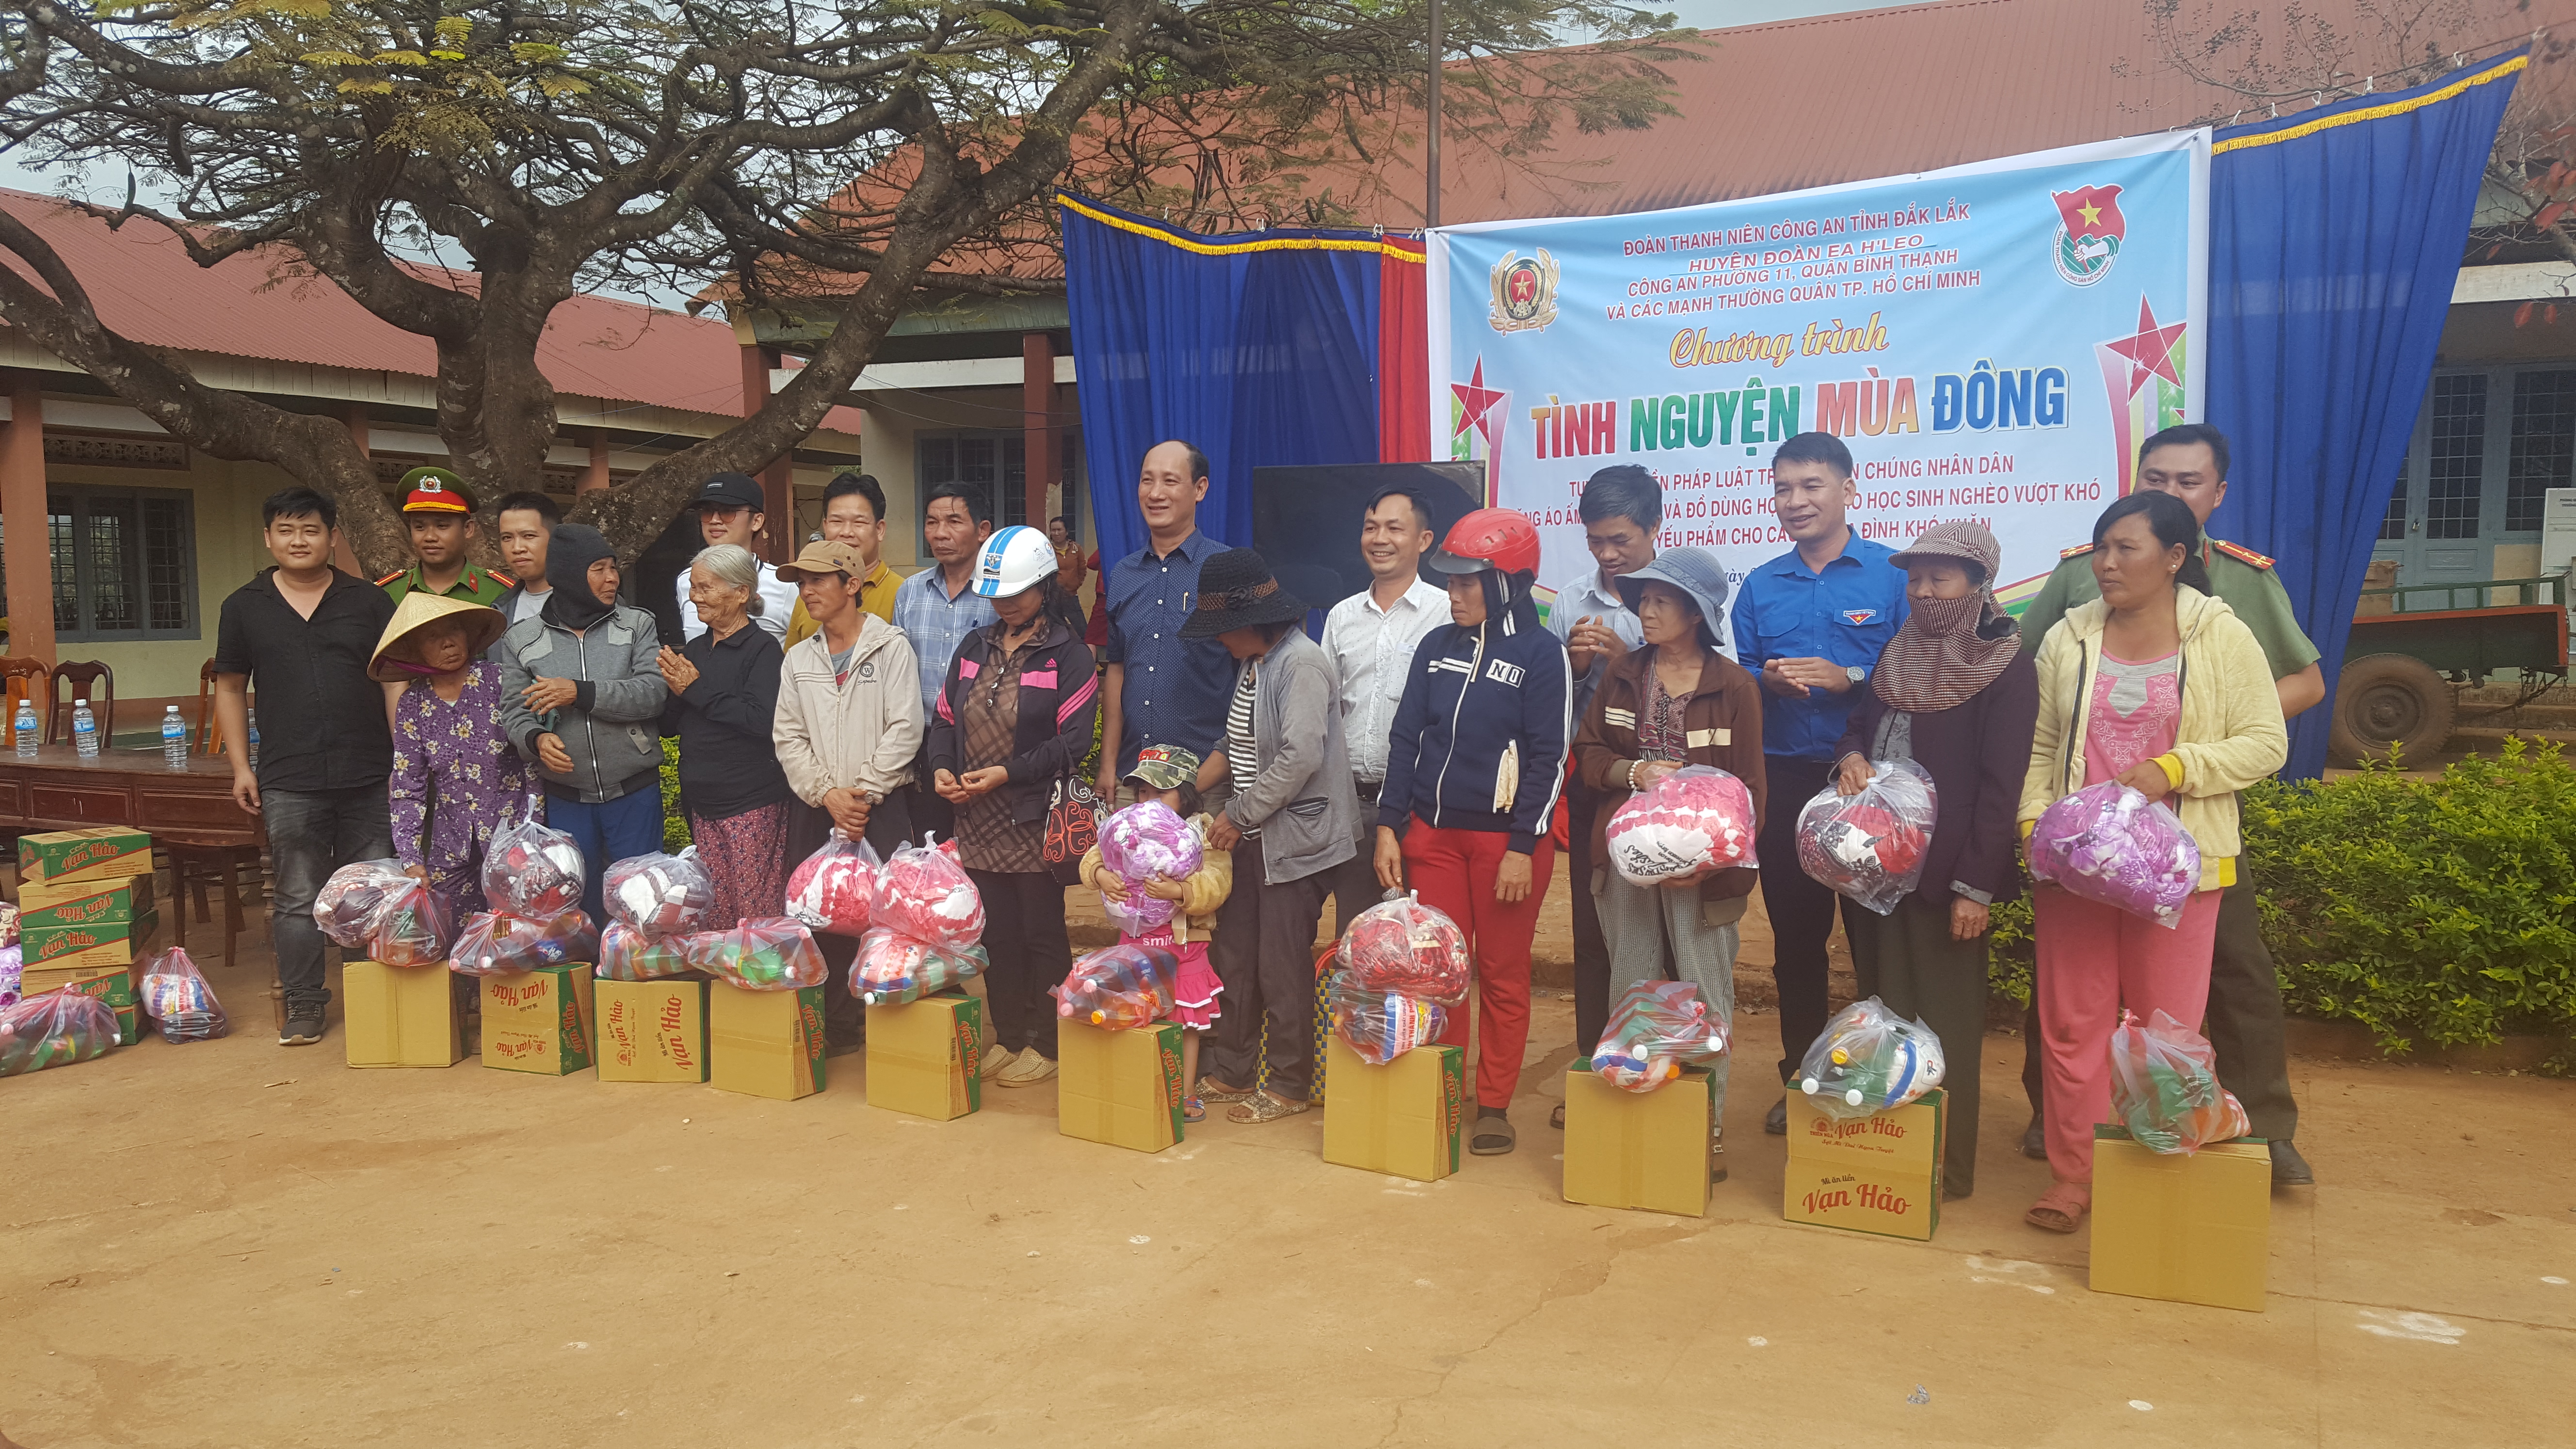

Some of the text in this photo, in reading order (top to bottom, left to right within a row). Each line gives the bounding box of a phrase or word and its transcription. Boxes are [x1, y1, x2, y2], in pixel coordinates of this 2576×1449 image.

[1624, 197, 1970, 256] ĐOÀN THANH NIÊN CÔNG AN TỈNH ĐẮK LẮK
[1689, 235, 1923, 272] HUYỆN ĐOÀN EA H'LEO
[1628, 249, 1958, 297] CÔNG AN PHƯỜNG 11, QUẬN BÌNH THẠNH
[1607, 270, 1980, 320] VÀ CÁC MẠNH THƯỜNG QUÂN TP. HỒ CHÍ MINH
[1669, 310, 1889, 368] Chương trình
[1531, 357, 2069, 460] TÌNH NGUYỆN MÙA ĐÔNG
[1673, 468, 1711, 490] PHÁP
[1716, 465, 1754, 490] LUẬT
[1865, 456, 1922, 480] CHÚNG
[1928, 452, 1973, 477] NHÂN
[1979, 451, 2013, 474] DÂN
[1664, 495, 1681, 519] VÀ
[1686, 494, 1706, 518] ĐỒ
[1711, 495, 1752, 517] DÙNG
[1867, 490, 1900, 512] HỌC
[1906, 489, 1944, 507] SINH
[1949, 481, 2009, 505] NGHÈO
[2014, 482, 2059, 505] VƯỢT
[2065, 477, 2100, 501] KHÓ
[1545, 506, 1562, 526] ÁO
[1862, 517, 1899, 539] ĐÌNH
[1657, 524, 1682, 548] YẾU
[1687, 520, 1726, 546] PHẨM
[1731, 527, 1762, 544] CHO
[62, 851, 89, 871] Vạn
[89, 841, 120, 857] Hảo
[54, 894, 113, 922] Vạn Hảo
[39, 938, 65, 959] Vạn
[66, 931, 97, 946] Hảo
[490, 979, 548, 1006] Vạn Hảo
[610, 999, 623, 1024] Hảo
[615, 1026, 631, 1049] Vạn
[660, 994, 693, 1070] Vạn Hảo
[802, 1005, 818, 1030] Vạn
[810, 1030, 823, 1061] Hảo
[495, 1039, 533, 1056] Vạn Hảo
[958, 1021, 973, 1047] Vạn
[966, 1047, 979, 1079] Hảo
[1162, 1048, 1182, 1109] Vạn Hảo
[1445, 1071, 1456, 1101] Vạn
[1449, 1101, 1460, 1137] Hảo
[1835, 1117, 1908, 1139] Vạn Hảo
[1803, 1183, 1912, 1215] Vạn Hảo
